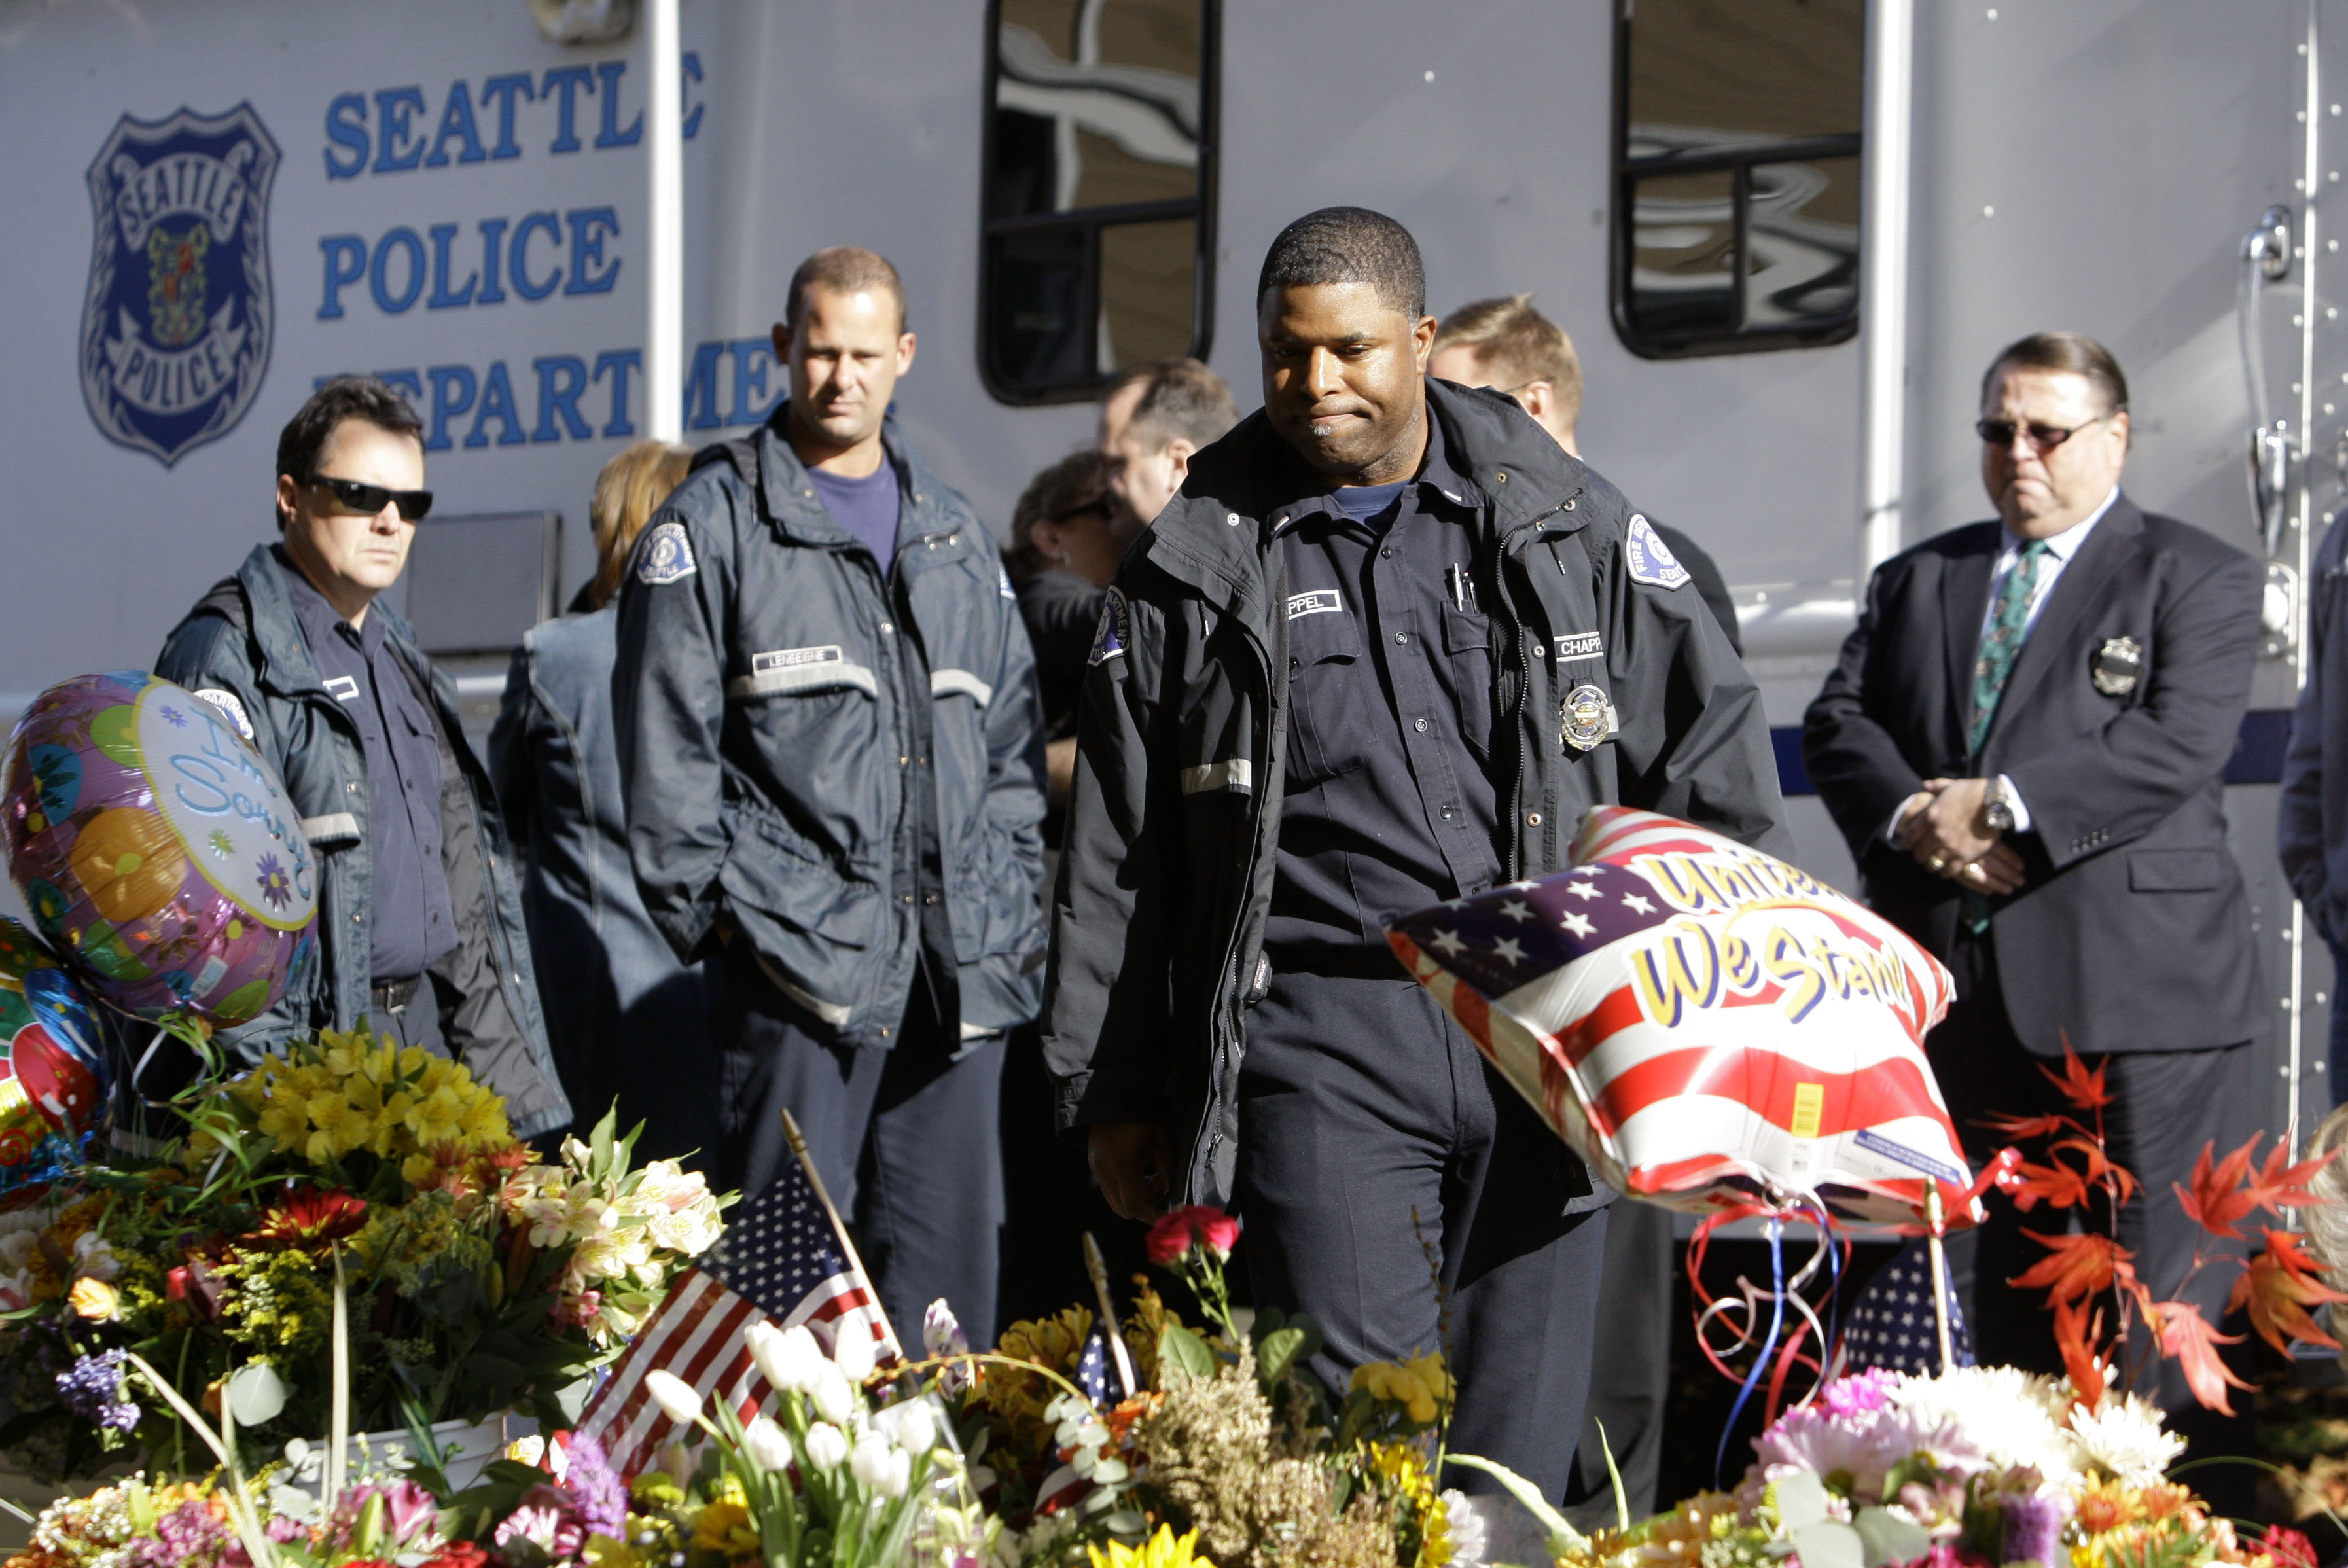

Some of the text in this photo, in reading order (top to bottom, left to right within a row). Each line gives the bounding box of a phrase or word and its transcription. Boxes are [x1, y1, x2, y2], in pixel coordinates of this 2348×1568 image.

[118, 161, 241, 232] SEATTLE
[317, 204, 623, 321] POLICE
[122, 338, 226, 406] POLICE
[1631, 540, 1648, 573] FIRE
[1631, 921, 1759, 1028] We
